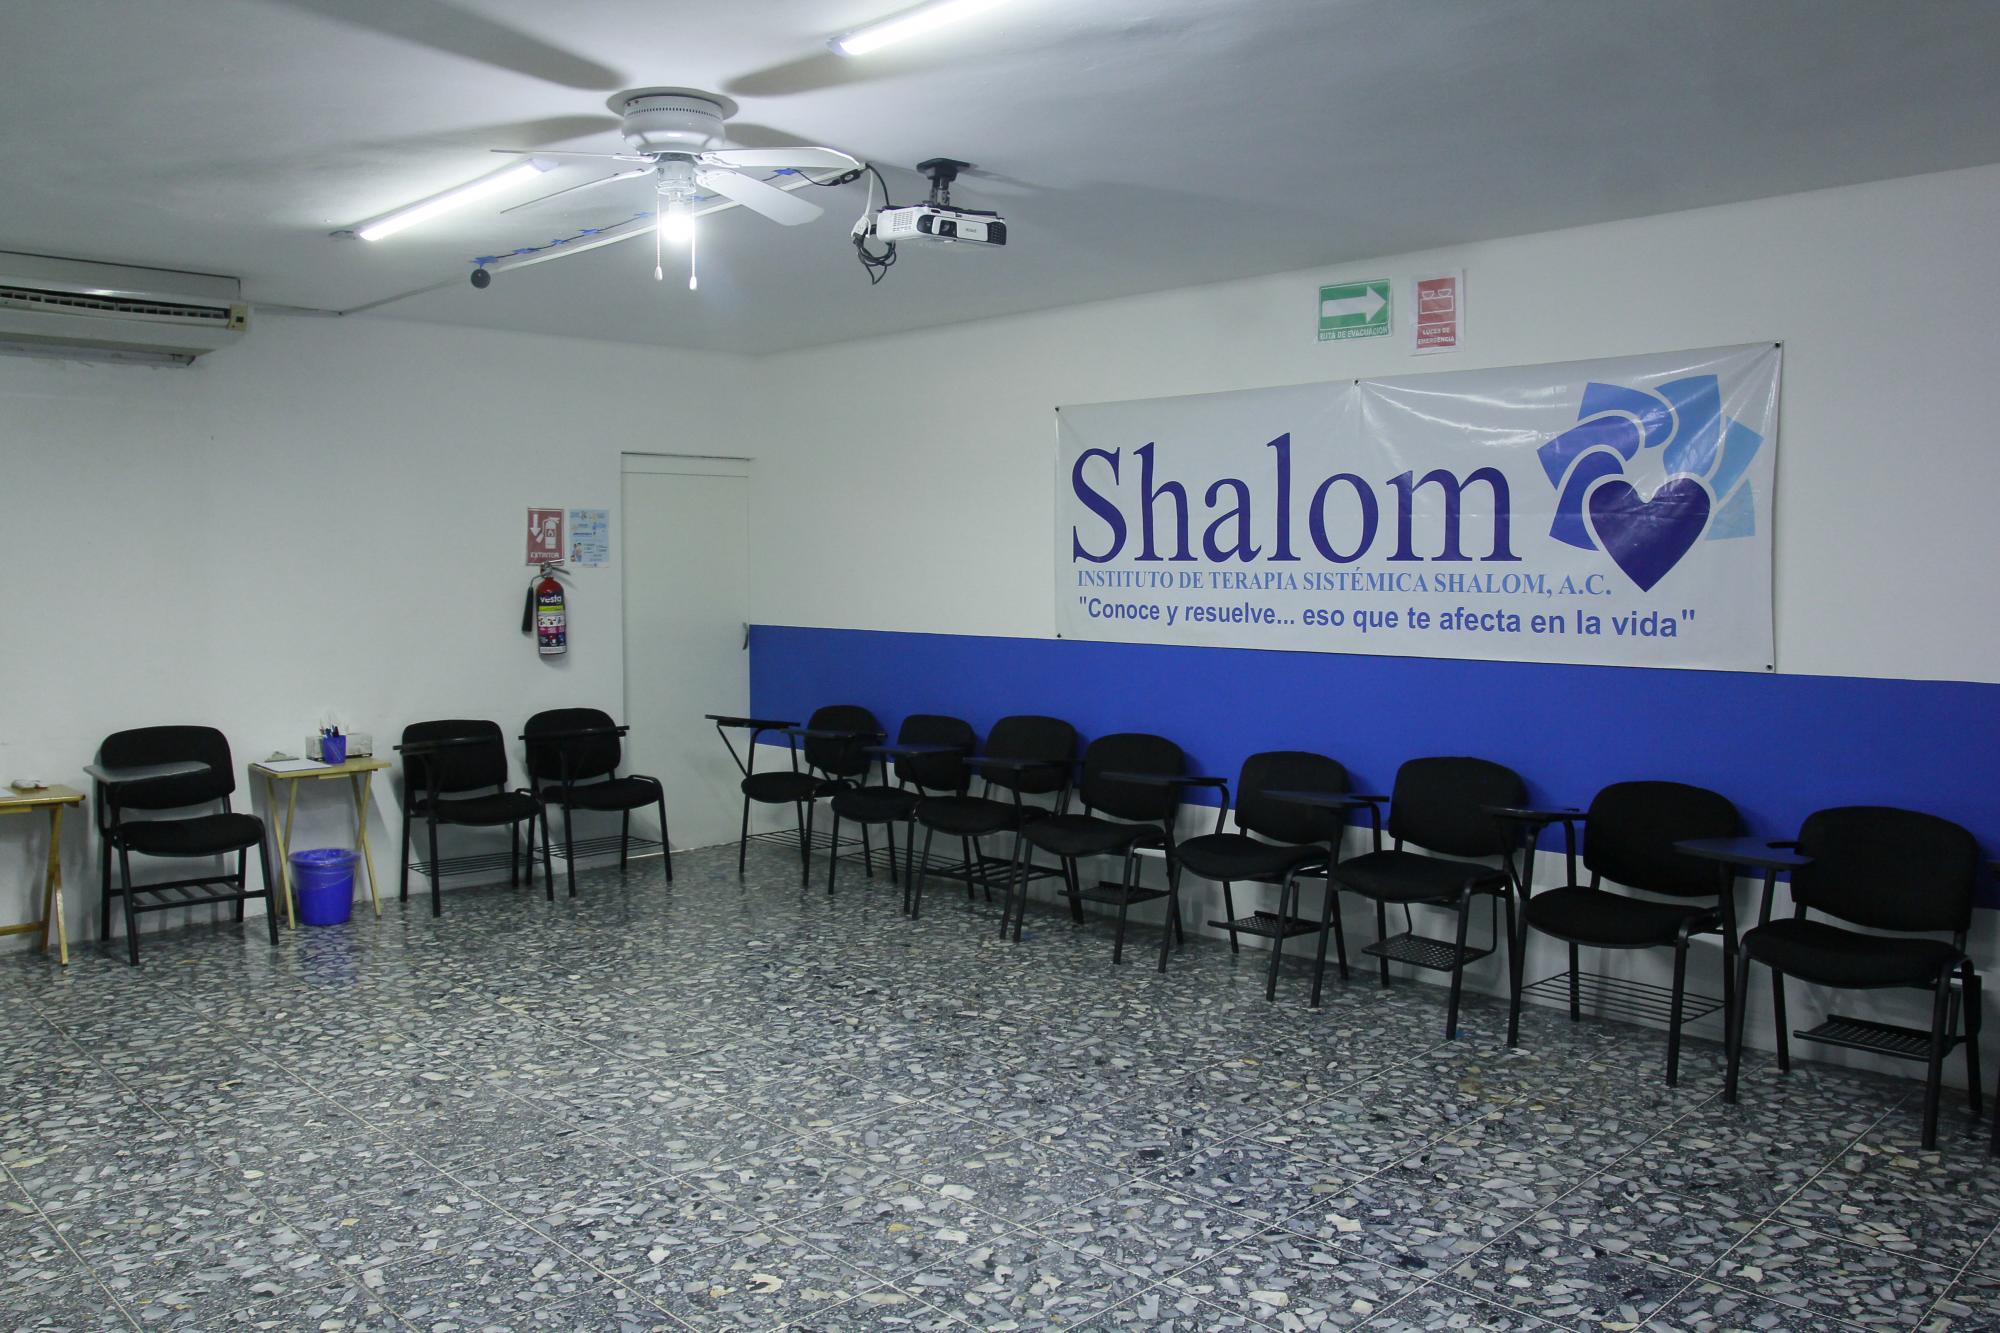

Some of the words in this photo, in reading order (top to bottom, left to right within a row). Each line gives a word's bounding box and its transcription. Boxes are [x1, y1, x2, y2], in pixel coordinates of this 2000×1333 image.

[1337, 330, 1346, 338] DE
[1071, 432, 1523, 565] Shalom
[1077, 570, 1174, 589] INSTITUTO
[1179, 571, 1204, 590] DE
[1209, 571, 1298, 591] TERAPIA
[1303, 567, 1429, 593] SISTÉMICA
[1434, 573, 1553, 598] SHALOM,
[1558, 574, 1613, 596] A.C.
[1079, 596, 1160, 621] "Conoce
[1166, 604, 1179, 627] y
[1184, 601, 1296, 626] resuelve...
[1302, 608, 1346, 628] eso
[1352, 609, 1400, 634] que
[1407, 607, 1432, 630] te
[1439, 607, 1521, 633] afecta
[1530, 613, 1566, 634] en
[1576, 609, 1602, 636] la
[1611, 608, 1696, 638] vida"
